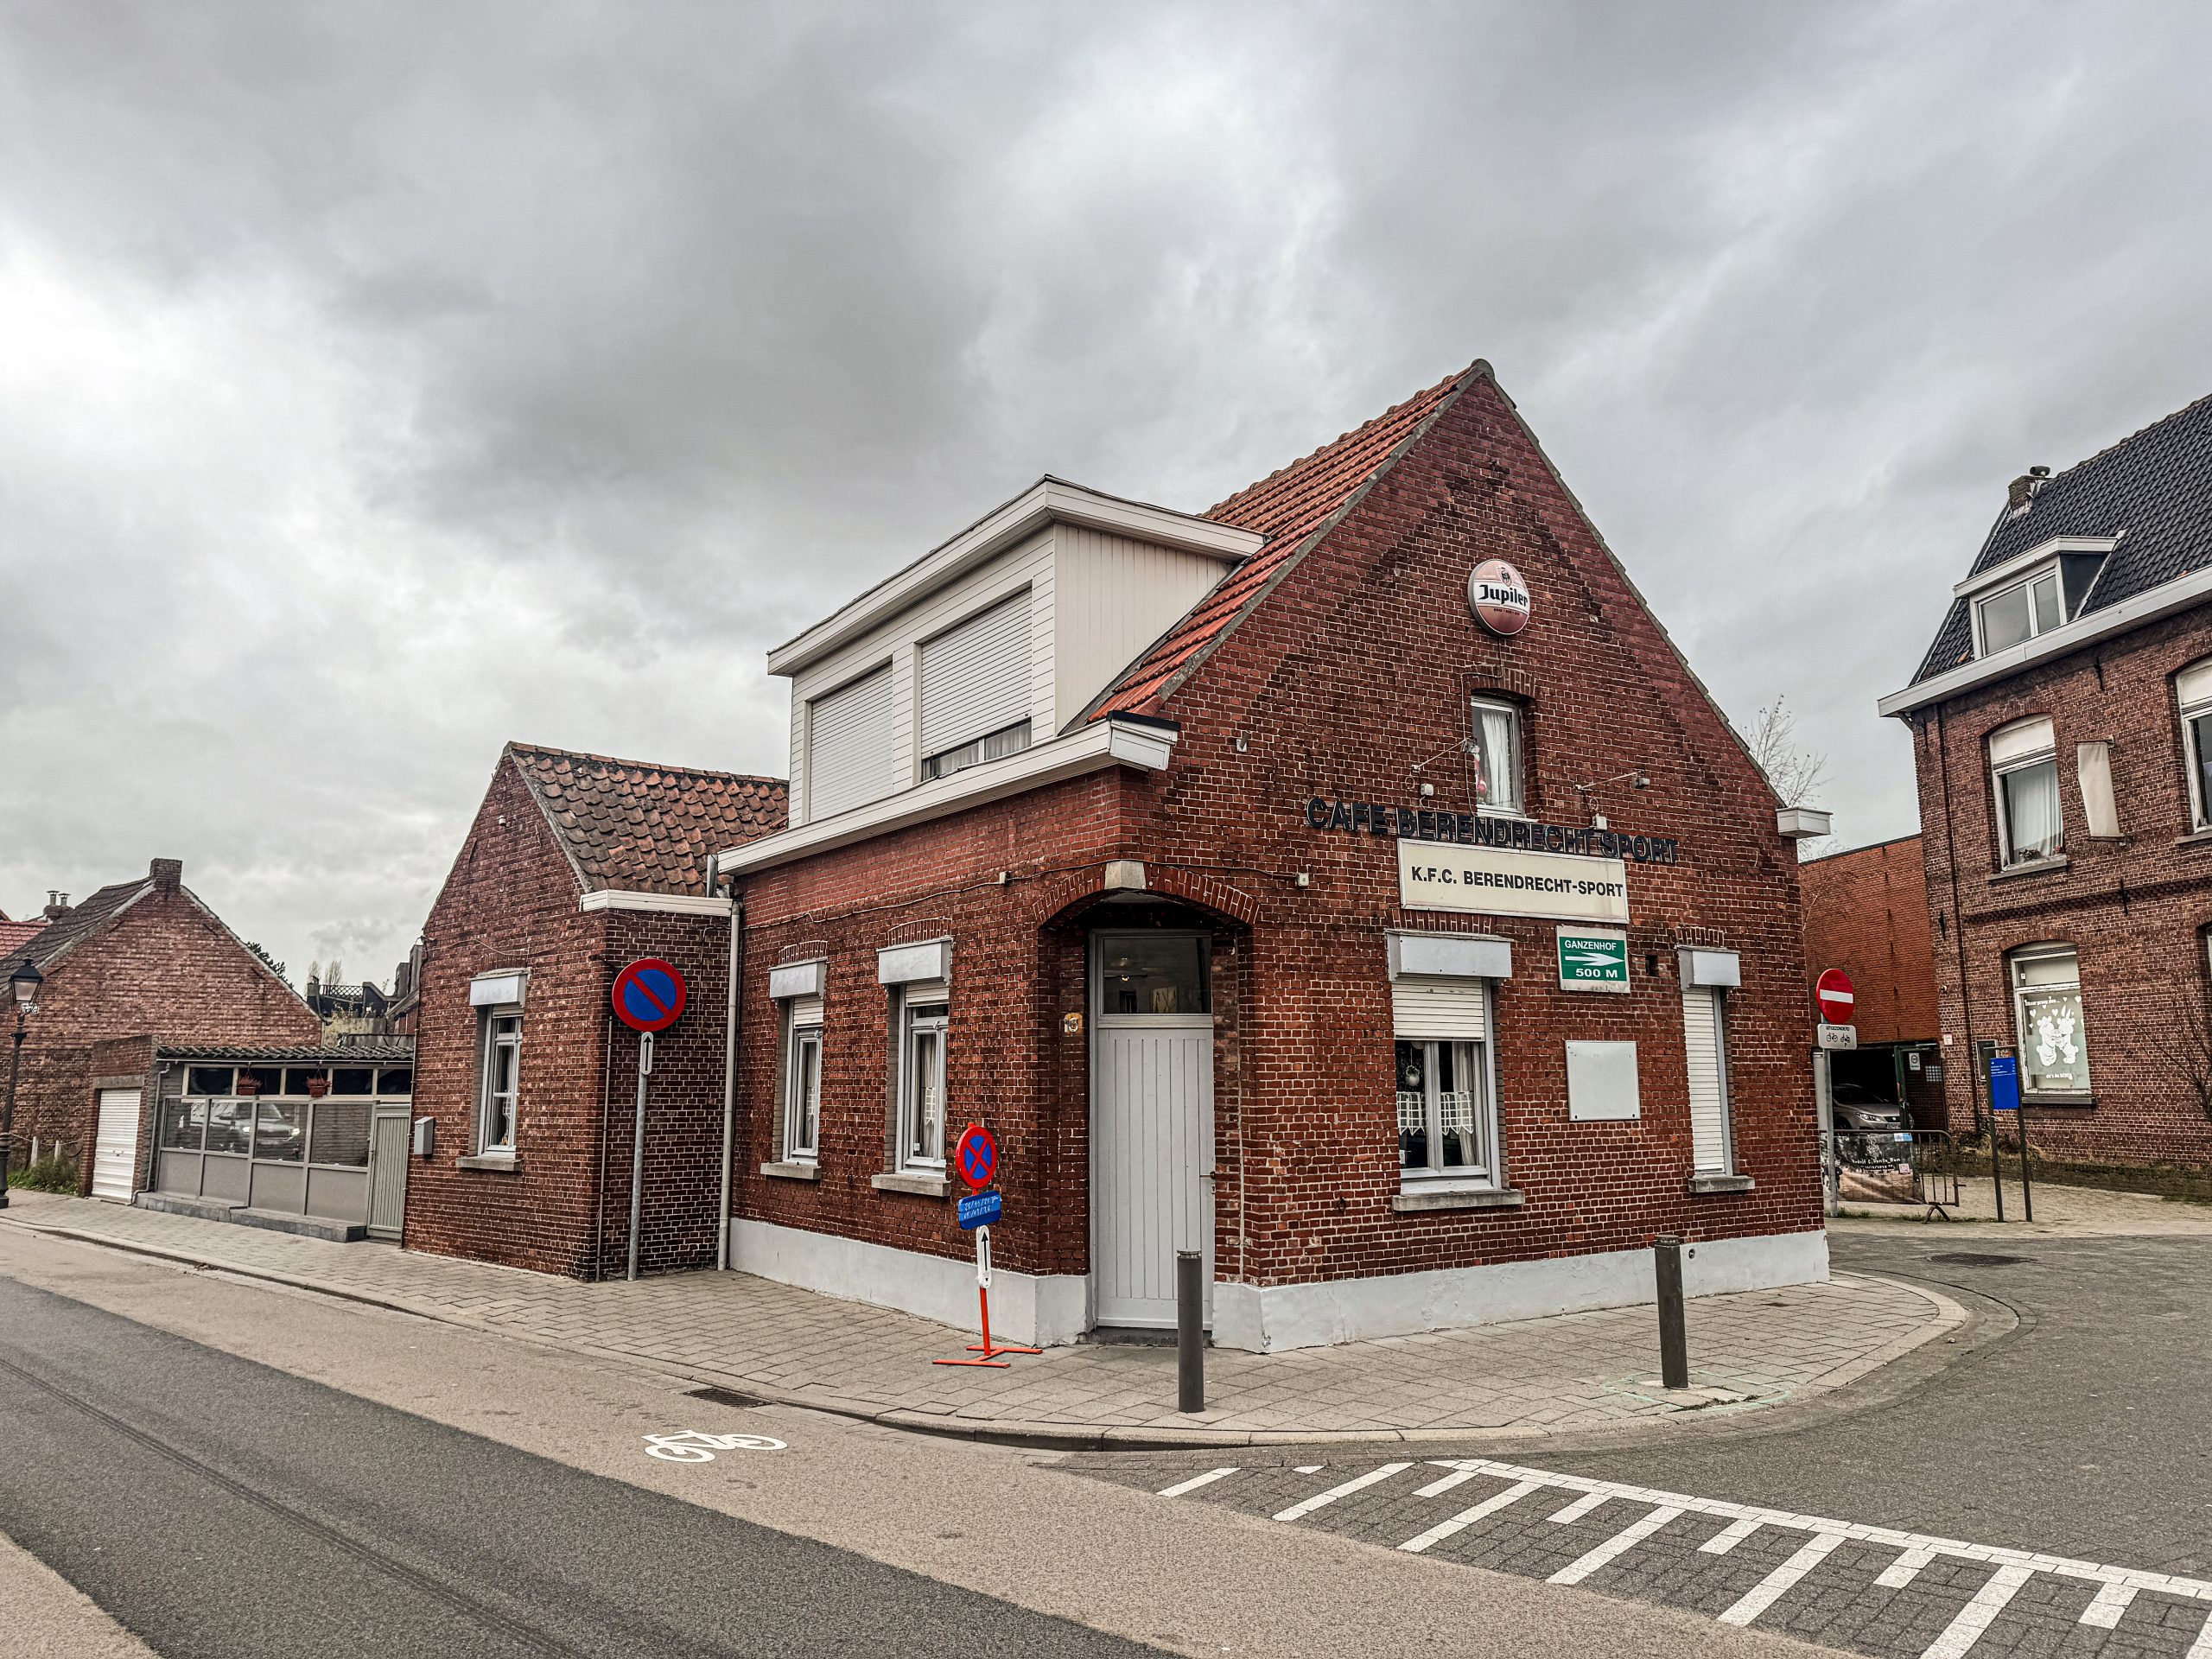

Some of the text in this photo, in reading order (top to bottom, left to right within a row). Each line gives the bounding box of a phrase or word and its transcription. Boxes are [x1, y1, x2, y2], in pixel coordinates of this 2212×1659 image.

[1478, 584, 1528, 607] Jupiler
[1306, 798, 1679, 863] CAFE BERENDRECHT SPORT
[1411, 866, 1624, 897] K.F.C. BERENDRECHT-SPORT
[1564, 939, 1617, 951] GANZENHOF
[1575, 968, 1618, 978] 500 M
